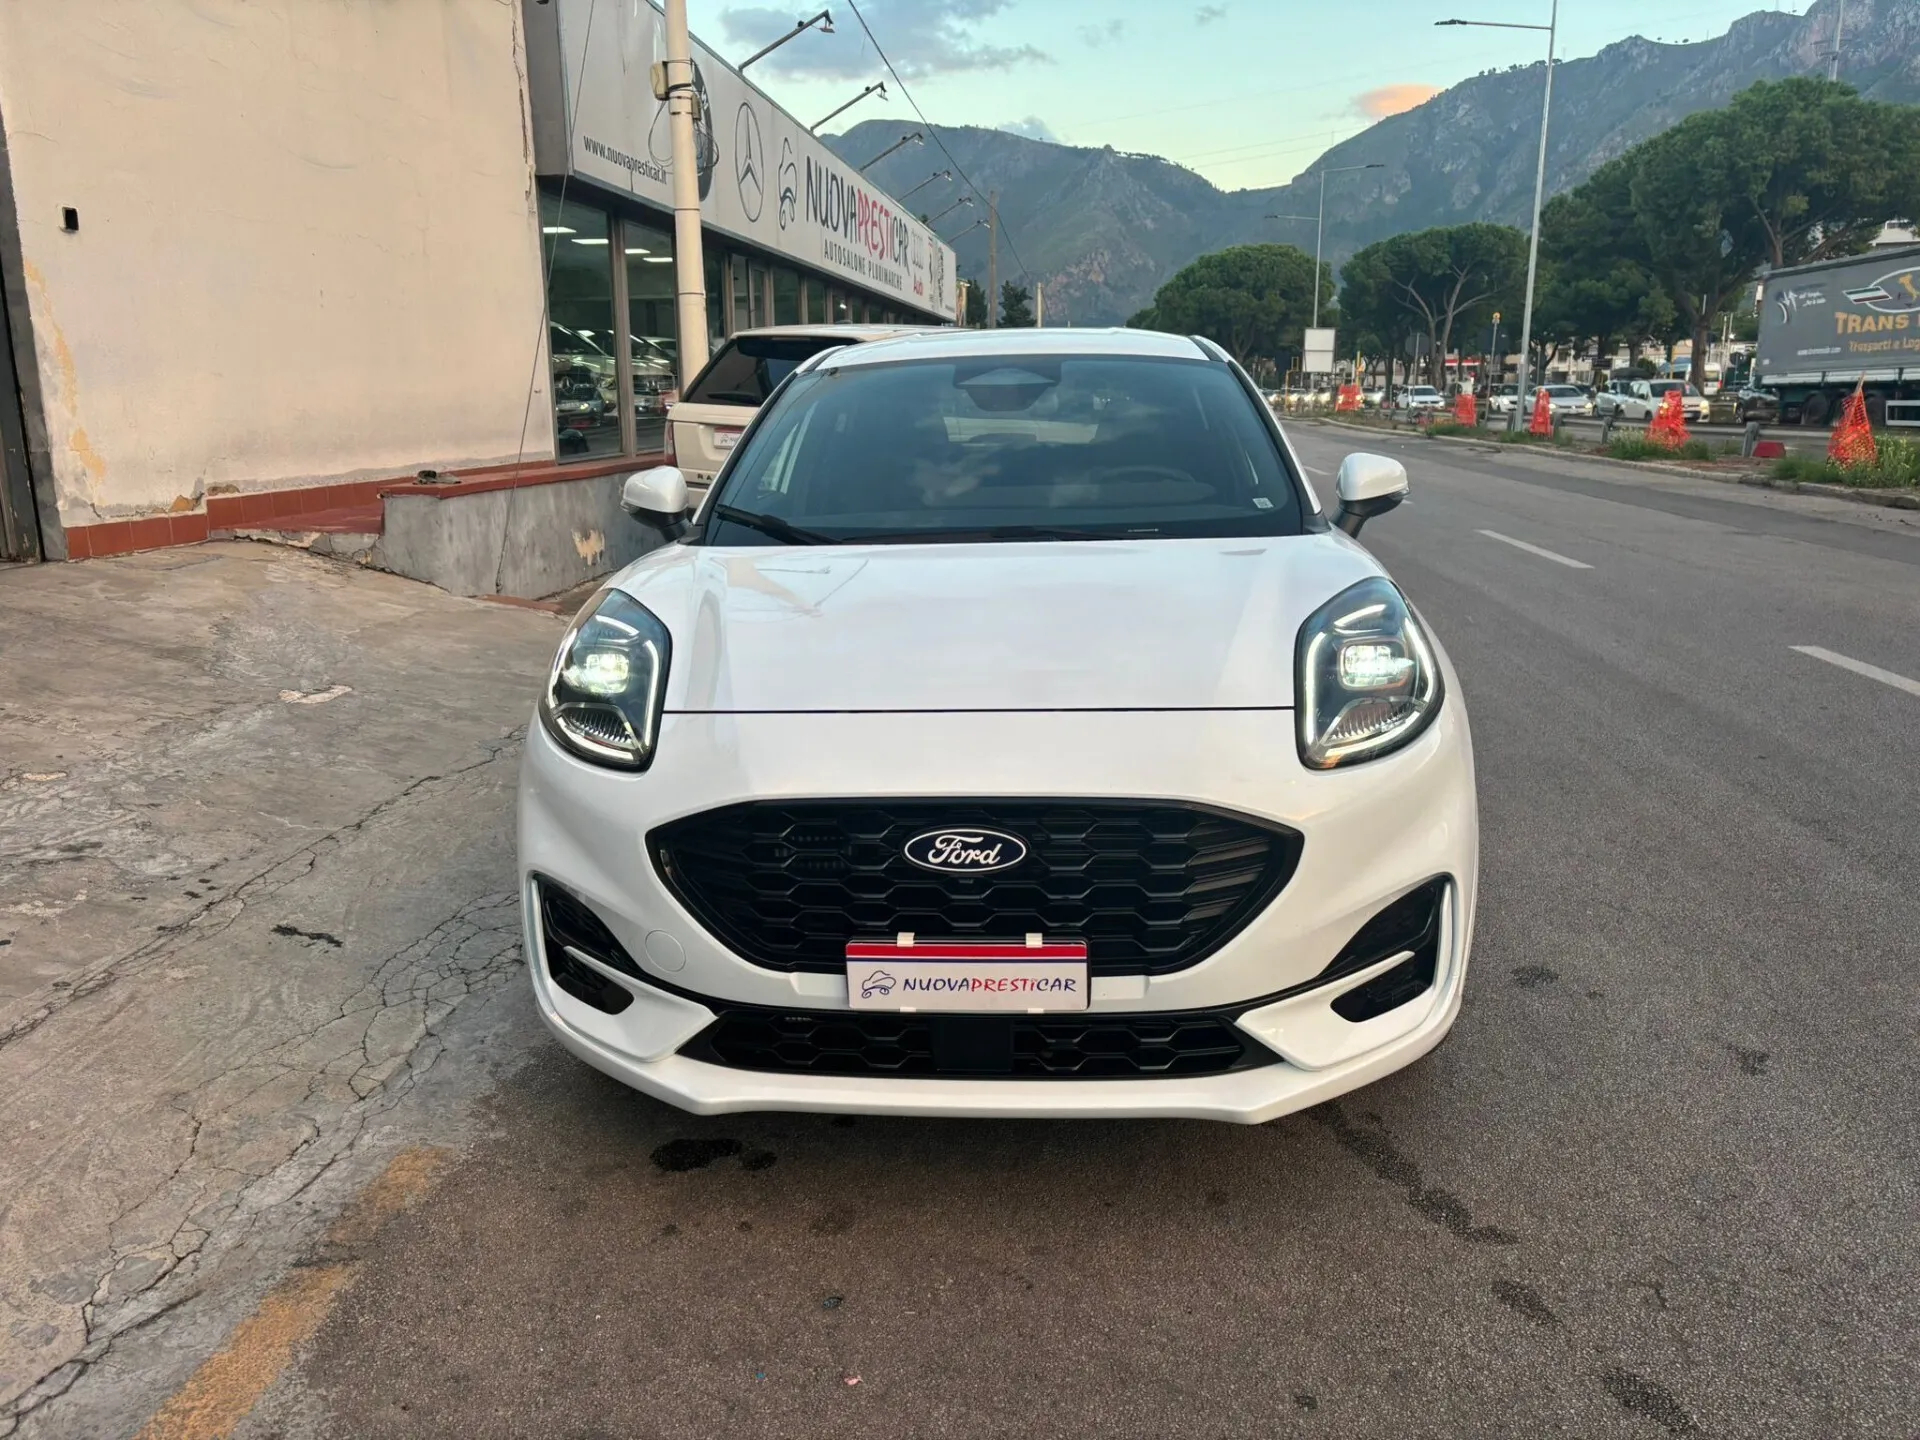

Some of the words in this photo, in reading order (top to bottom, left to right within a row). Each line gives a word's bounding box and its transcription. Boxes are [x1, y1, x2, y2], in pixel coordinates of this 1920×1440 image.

[583, 135, 667, 185] www.nuovapresticar.it
[806, 155, 911, 277] NUOVAPRESTICAR
[824, 238, 866, 276] AUTOSALONE
[1835, 311, 1910, 335] TRANS
[927, 834, 1003, 865] Ford
